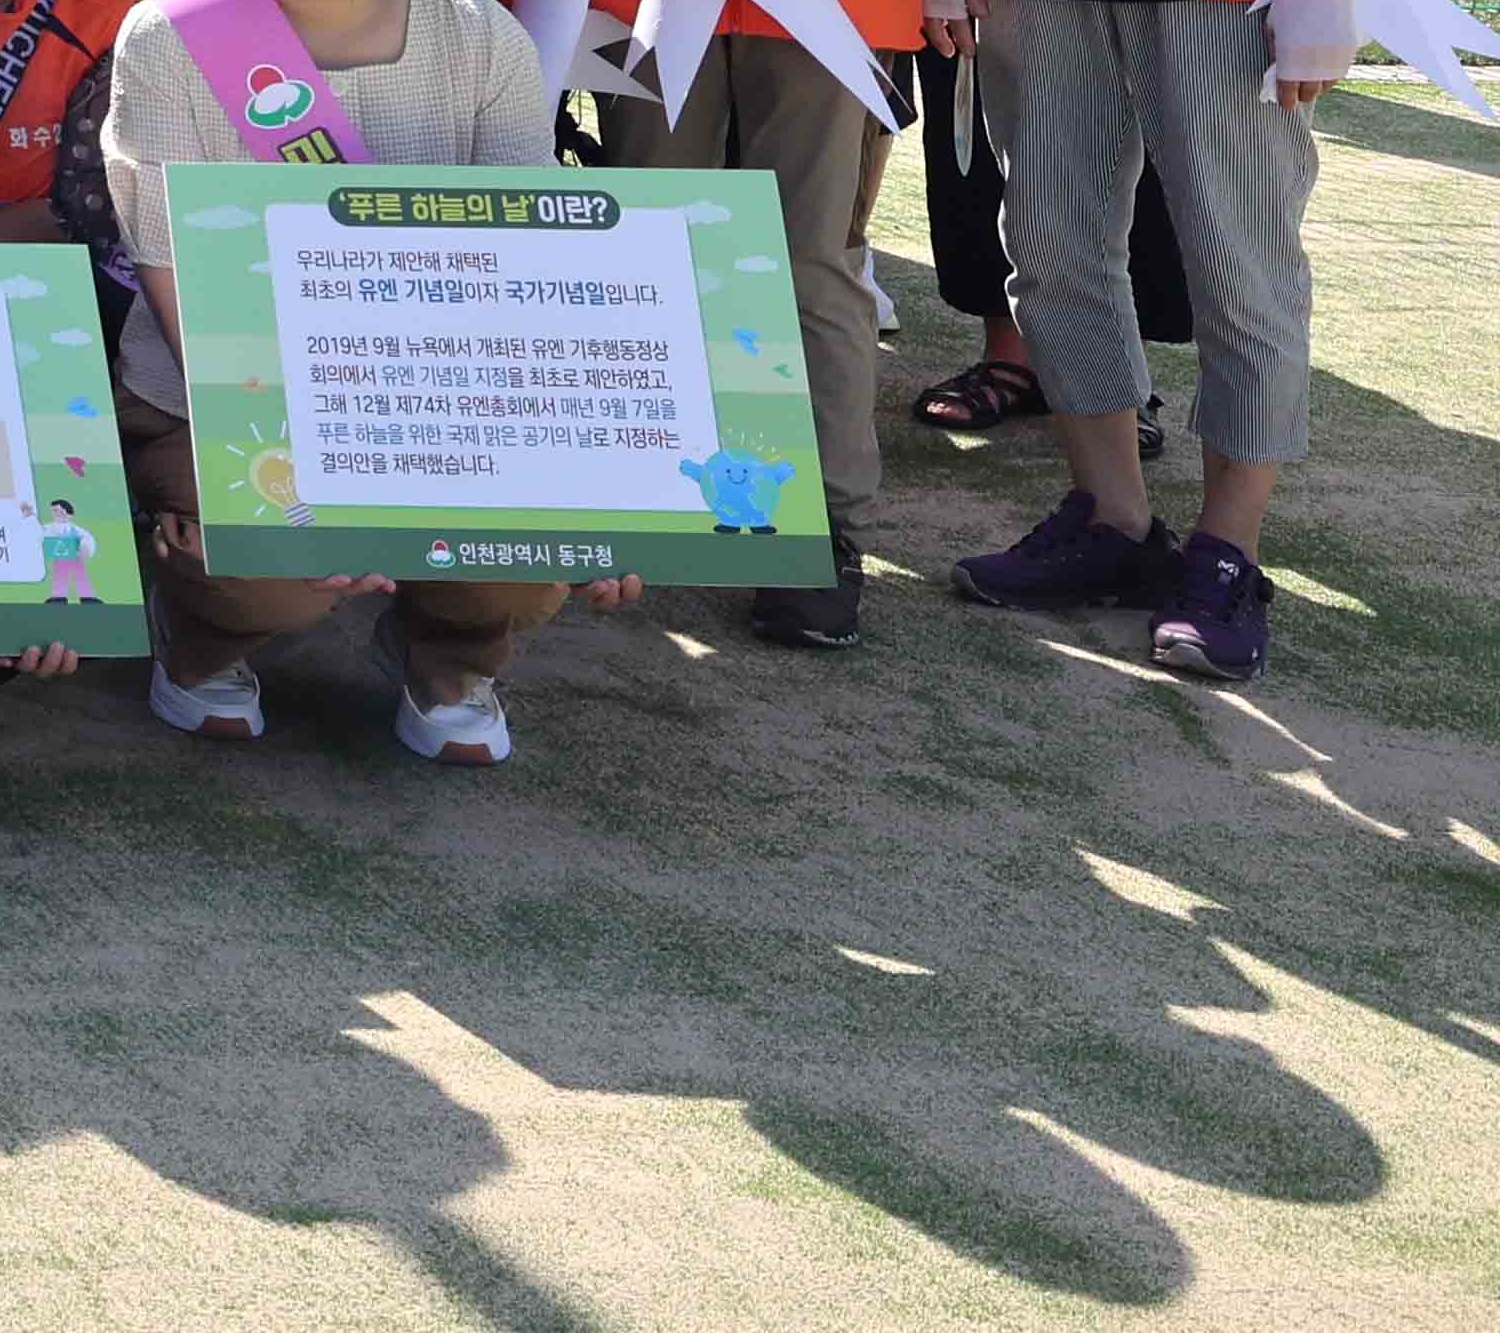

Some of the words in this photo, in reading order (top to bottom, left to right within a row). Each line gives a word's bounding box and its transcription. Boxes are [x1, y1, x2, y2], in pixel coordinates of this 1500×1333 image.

[409, 193, 495, 223] 하늘의
[312, 394, 348, 415] 그해
[352, 394, 392, 416] 12월
[394, 395, 453, 417] 제74차
[455, 396, 558, 419] 유엔총회에서
[559, 398, 596, 419] 매년
[598, 398, 629, 420] 9월
[630, 398, 678, 421] 7일을
[315, 422, 351, 444] 푸른
[354, 423, 405, 445] 하늘을
[408, 424, 443, 446] 위한
[445, 424, 481, 446] 국제
[483, 425, 519, 447] 맑은
[521, 426, 573, 448] 공기의
[575, 427, 611, 449] 날로
[613, 427, 681, 450] 지정하는
[457, 542, 553, 567] 인천광역시
[557, 544, 614, 568] 동구청
